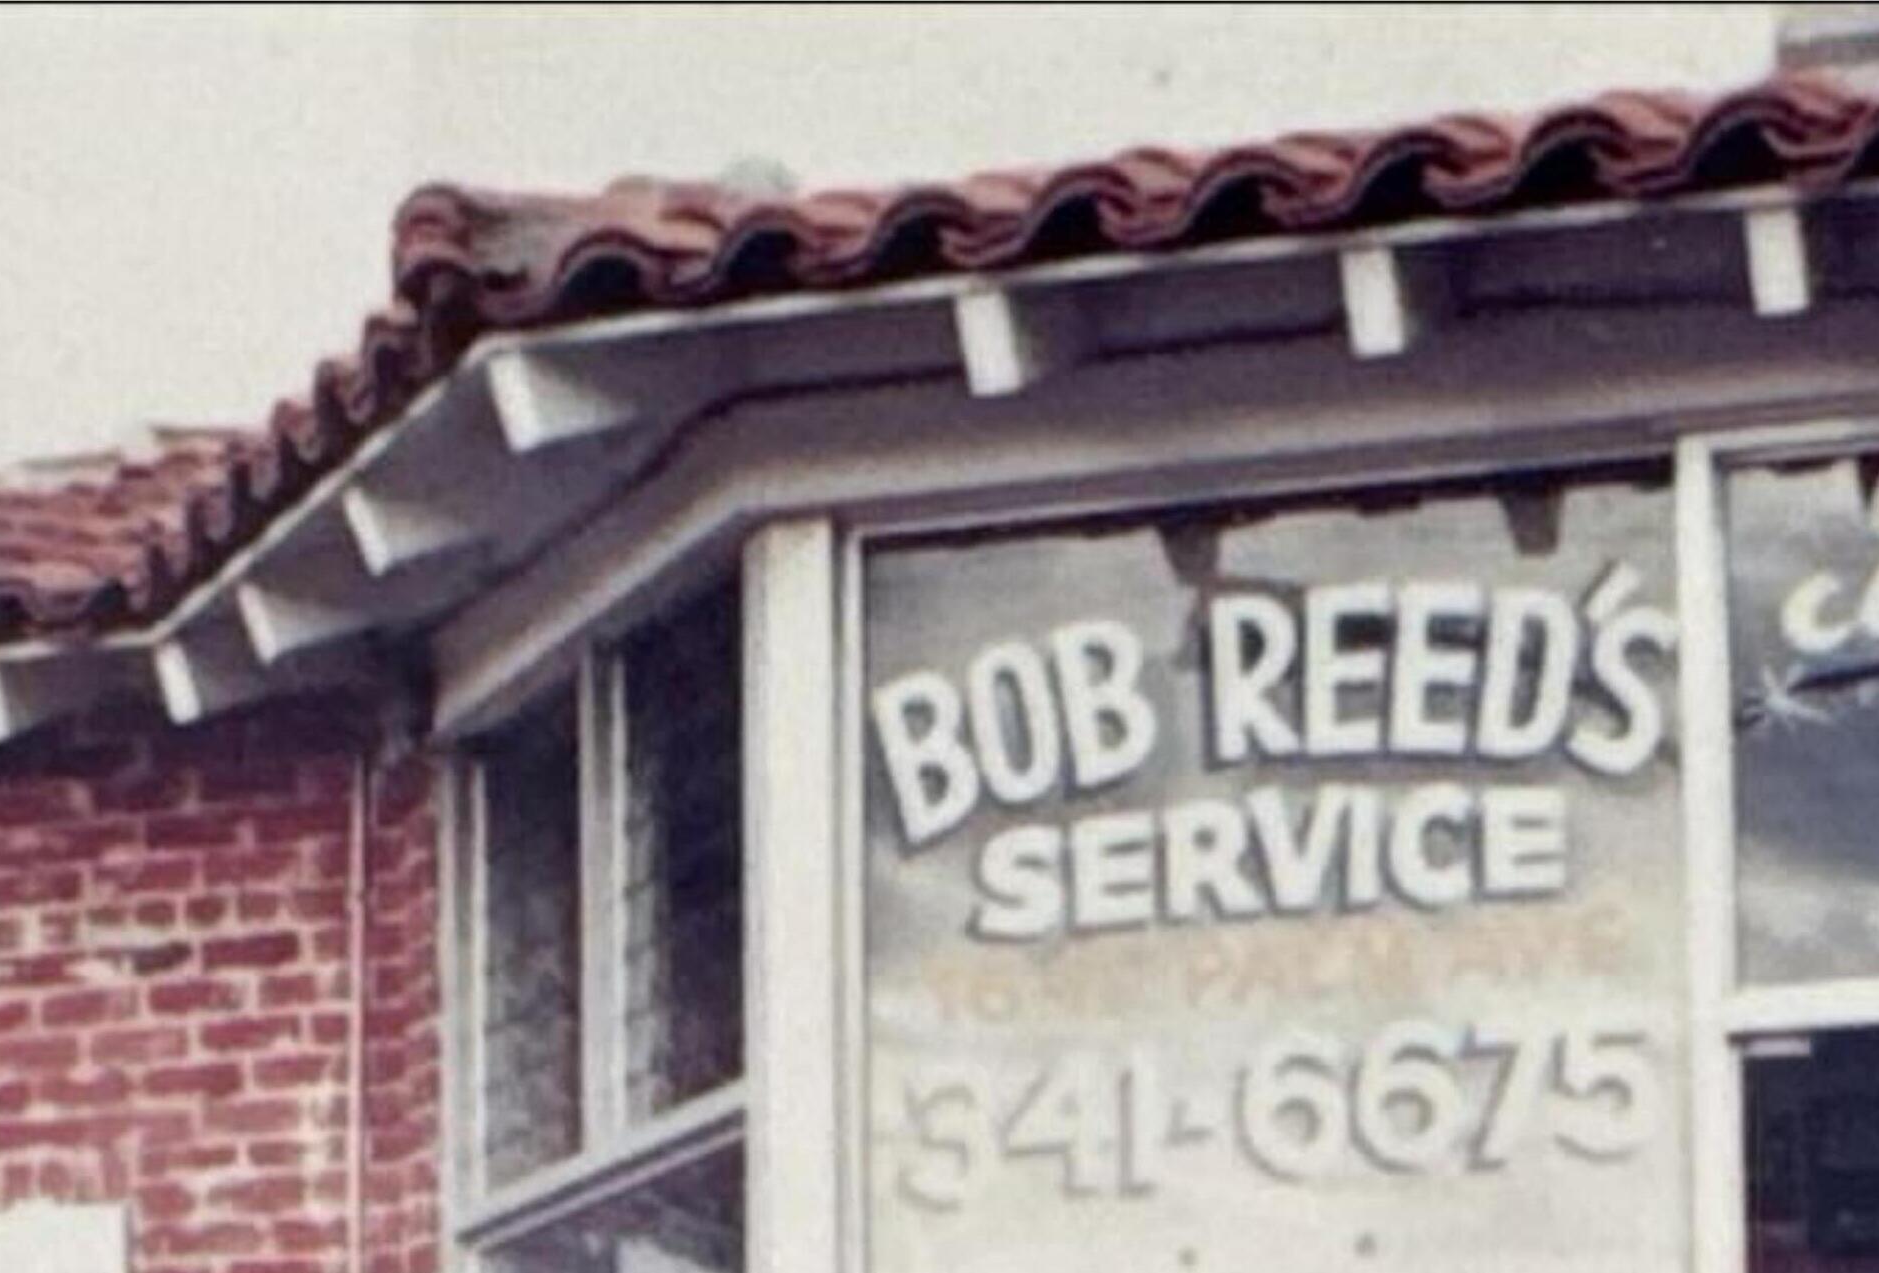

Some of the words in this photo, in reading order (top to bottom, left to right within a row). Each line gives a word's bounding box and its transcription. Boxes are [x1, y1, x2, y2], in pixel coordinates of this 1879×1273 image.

[871, 615, 1156, 845] BOB
[1209, 562, 1678, 780] REED'S
[970, 788, 1572, 940] SERVICE
[893, 1017, 1657, 1210] 341-6675
